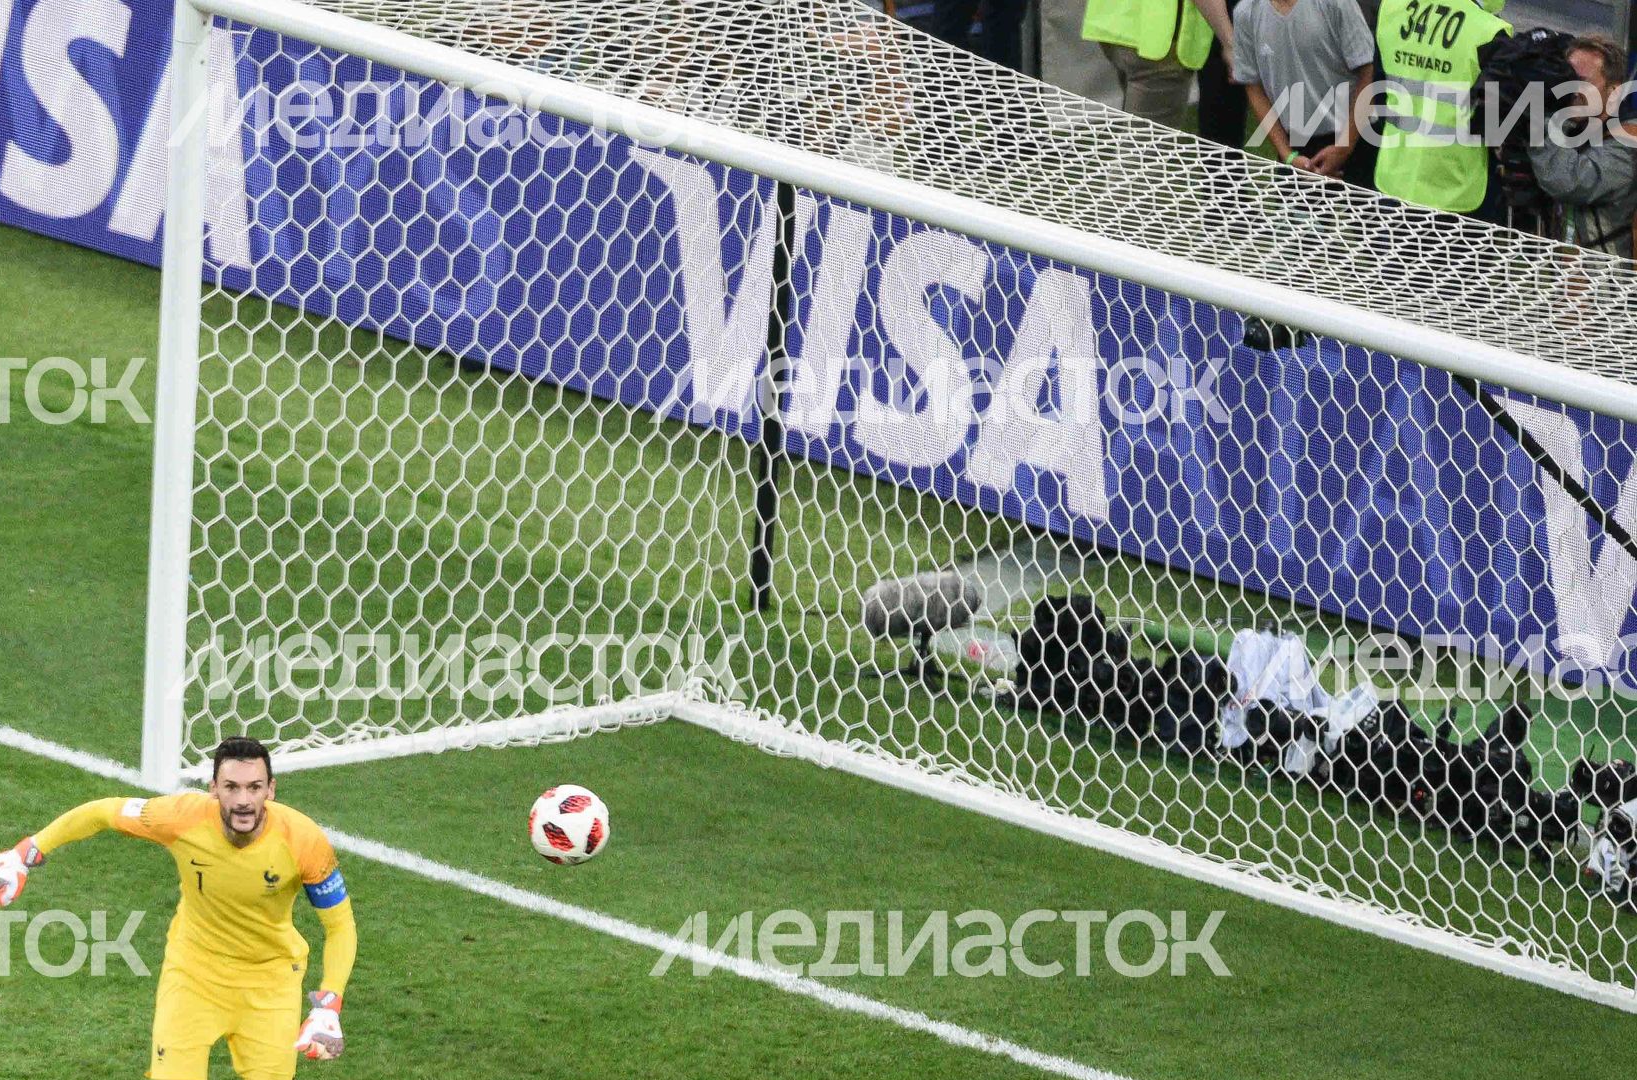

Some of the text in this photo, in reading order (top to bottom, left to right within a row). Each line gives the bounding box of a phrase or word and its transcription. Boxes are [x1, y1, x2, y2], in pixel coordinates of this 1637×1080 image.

[1400, 0, 1466, 50] 3470
[1394, 50, 1453, 74] STEWARD
[627, 145, 1107, 522] VISA
[195, 871, 204, 896] 1
